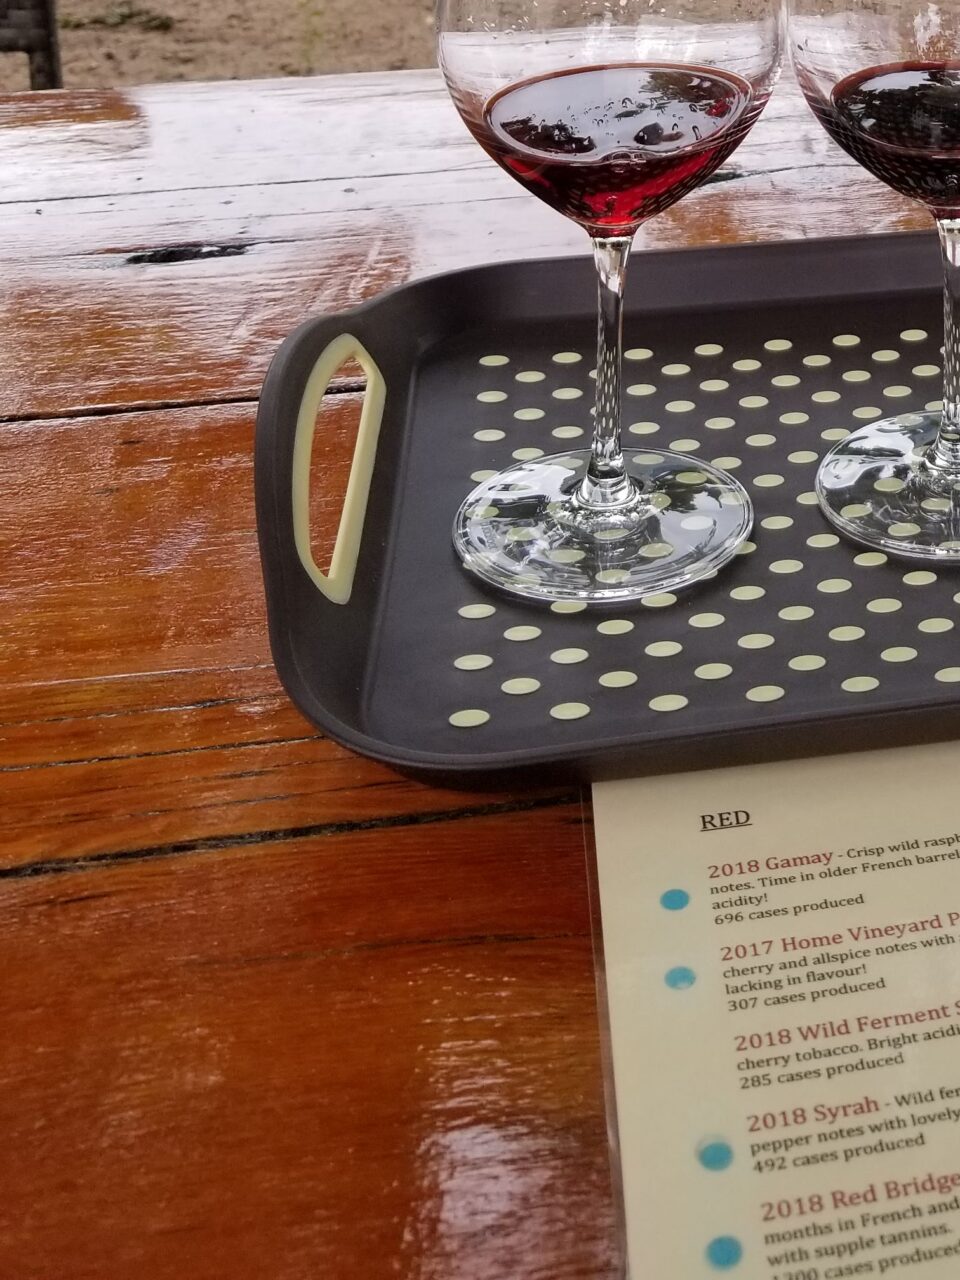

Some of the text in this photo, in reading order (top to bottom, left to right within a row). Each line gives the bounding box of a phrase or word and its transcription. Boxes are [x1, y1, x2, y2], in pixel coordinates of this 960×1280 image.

[700, 810, 751, 832] RED
[707, 859, 760, 879] 2018
[765, 852, 833, 870] Gamay
[846, 846, 885, 858] Crisp
[887, 839, 920, 852] wild
[710, 881, 755, 894] notes.
[757, 875, 796, 887] Time
[818, 866, 858, 879] older
[861, 856, 913, 872] French
[712, 892, 768, 910] acidity!
[714, 893, 864, 925] 696 cases produced
[720, 940, 773, 961] 2017
[781, 933, 843, 952] Home
[847, 914, 943, 941] Vineyard
[722, 963, 774, 978] cherry
[778, 955, 808, 970] and
[812, 949, 871, 965] allspice
[874, 941, 917, 955] notes
[919, 933, 956, 948] with
[725, 963, 867, 995] lacking in flavour!
[727, 977, 886, 1012] 307 cases produced
[734, 1028, 792, 1051] 2018
[796, 1019, 851, 1041] Wild
[856, 1005, 951, 1032] Ferment
[736, 1054, 791, 1071] cherry
[795, 1044, 863, 1062] tobacco.
[866, 1033, 918, 1050] Bright
[739, 1052, 904, 1090] 285 cases produced
[746, 1107, 807, 1132] 2018
[813, 1096, 880, 1124] Syrah
[894, 1089, 935, 1107] Wild
[750, 1134, 812, 1157] pepper
[817, 1126, 865, 1143] notes
[867, 1116, 907, 1133] with
[910, 1107, 960, 1126] lovely
[753, 1132, 925, 1173] 492 cases produced
[761, 1194, 824, 1222] 2018
[830, 1184, 878, 1209] Red
[764, 1222, 834, 1245] months
[860, 1204, 923, 1227] French
[927, 1195, 960, 1215] and
[766, 1247, 810, 1266] with
[814, 1236, 875, 1258] supple
